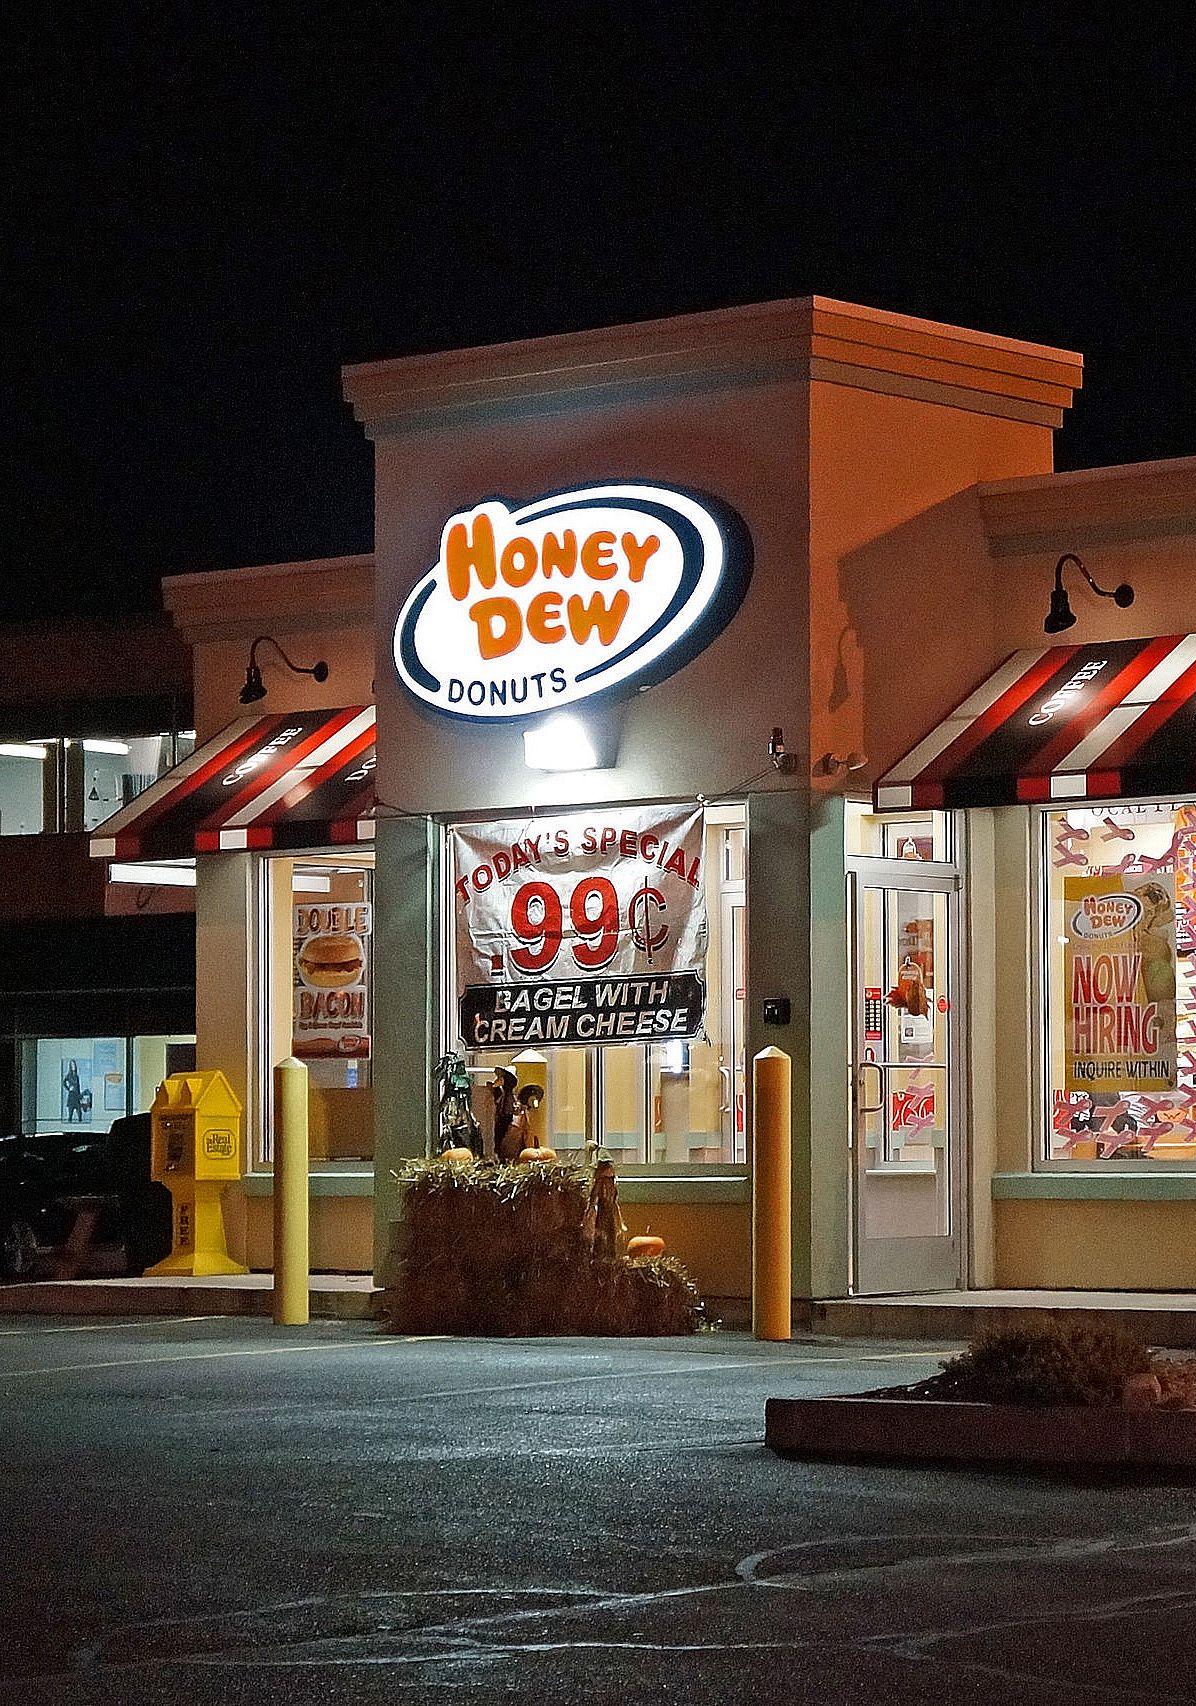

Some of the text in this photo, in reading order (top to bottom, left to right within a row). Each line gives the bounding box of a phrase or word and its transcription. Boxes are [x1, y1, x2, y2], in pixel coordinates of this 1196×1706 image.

[446, 513, 661, 601] HONEY
[469, 589, 630, 660] DEW
[448, 667, 567, 706] DONUTS
[455, 826, 702, 905] TODAY'S SPECIAL
[297, 907, 369, 937] DOUBLE
[1083, 931, 1114, 940] DONUTS
[1089, 914, 1127, 929] DEW
[1072, 953, 1143, 1004] NOW
[300, 990, 365, 1021] BACON
[494, 980, 669, 1014] BAGEL WITH
[474, 1008, 690, 1044] CREAM CHEESE
[1072, 1002, 1161, 1056] HIRING
[1074, 1060, 1170, 1081] INQUIRE WITHIN
[212, 1133, 231, 1144] Real
